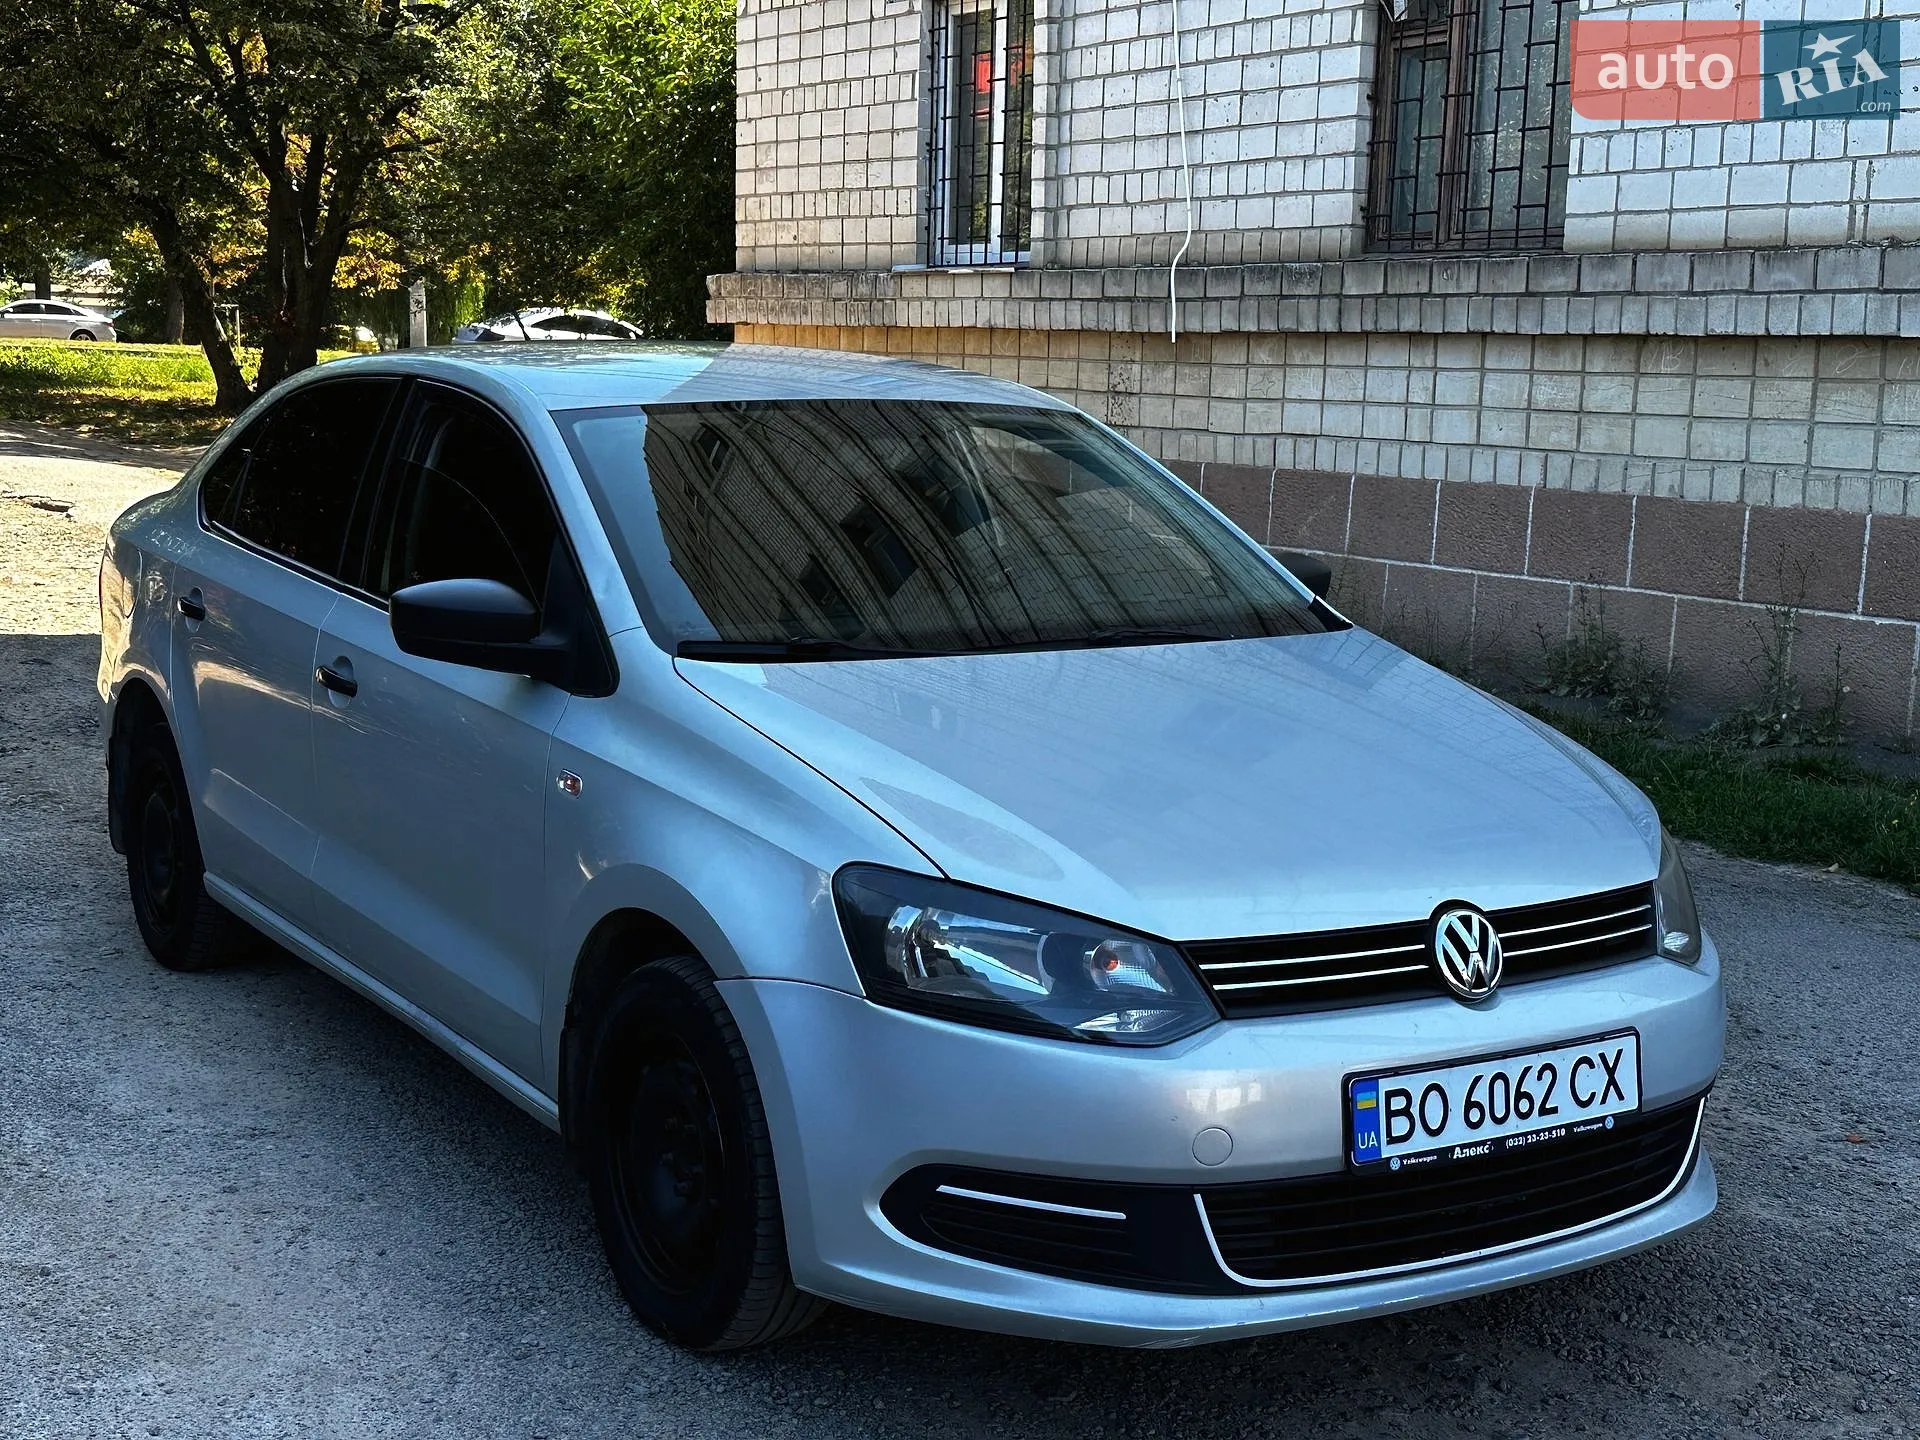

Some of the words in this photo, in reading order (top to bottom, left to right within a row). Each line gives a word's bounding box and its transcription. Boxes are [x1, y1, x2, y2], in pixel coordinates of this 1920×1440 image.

[1384, 1082, 1449, 1146] BO
[1463, 1062, 1558, 1130] 6062
[1569, 1048, 1625, 1109] CX
[1357, 1132, 1378, 1150] UA
